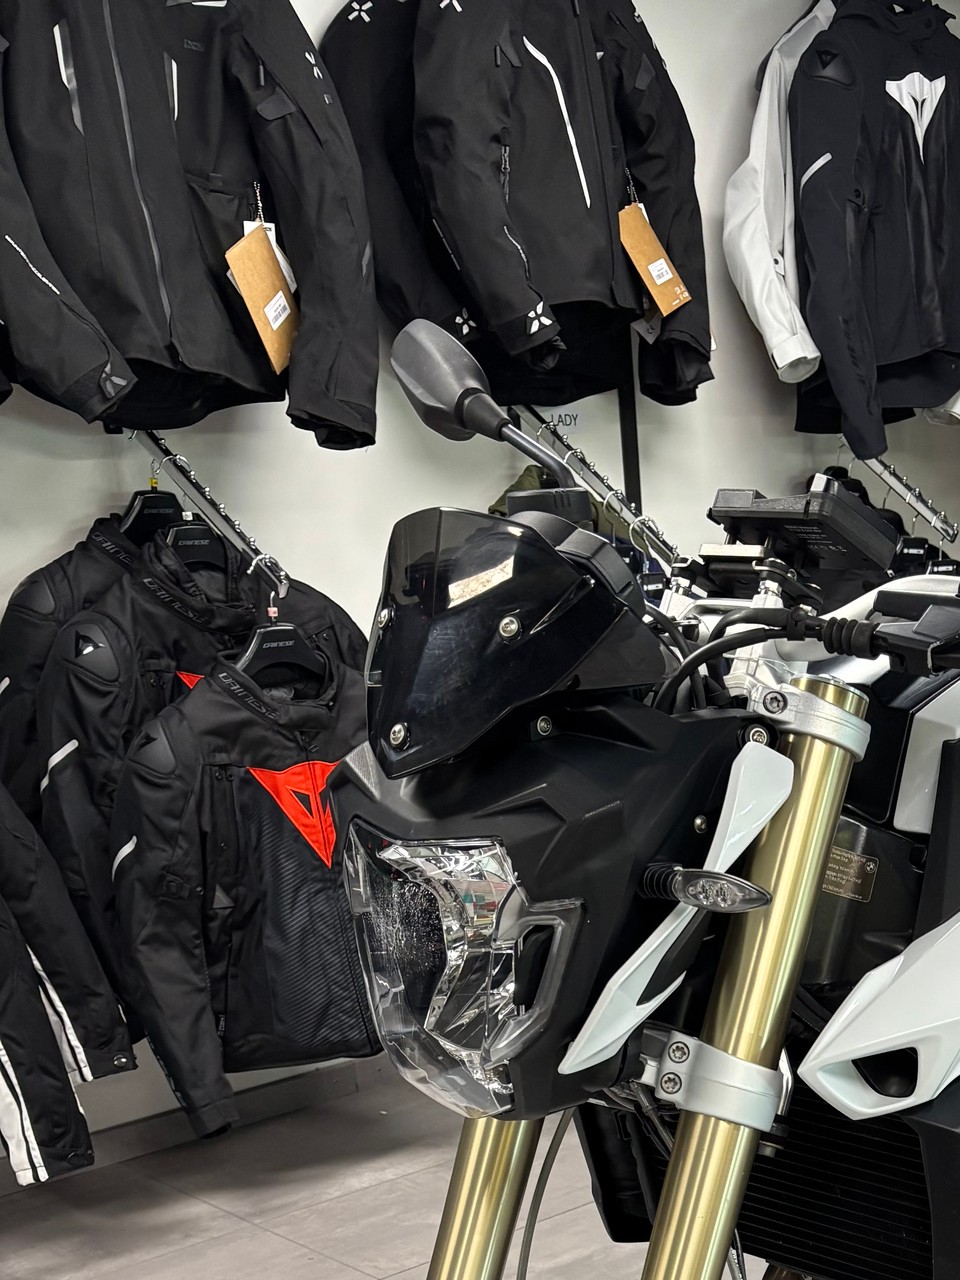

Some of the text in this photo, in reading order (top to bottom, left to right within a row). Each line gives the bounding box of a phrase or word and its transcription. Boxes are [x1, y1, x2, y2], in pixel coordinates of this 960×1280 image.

[551, 413, 578, 427] LADY
[90, 531, 135, 566] DAINE
[177, 538, 210, 546] DAINESE
[261, 639, 296, 649] DAINESE
[217, 671, 281, 720] DAINESE
